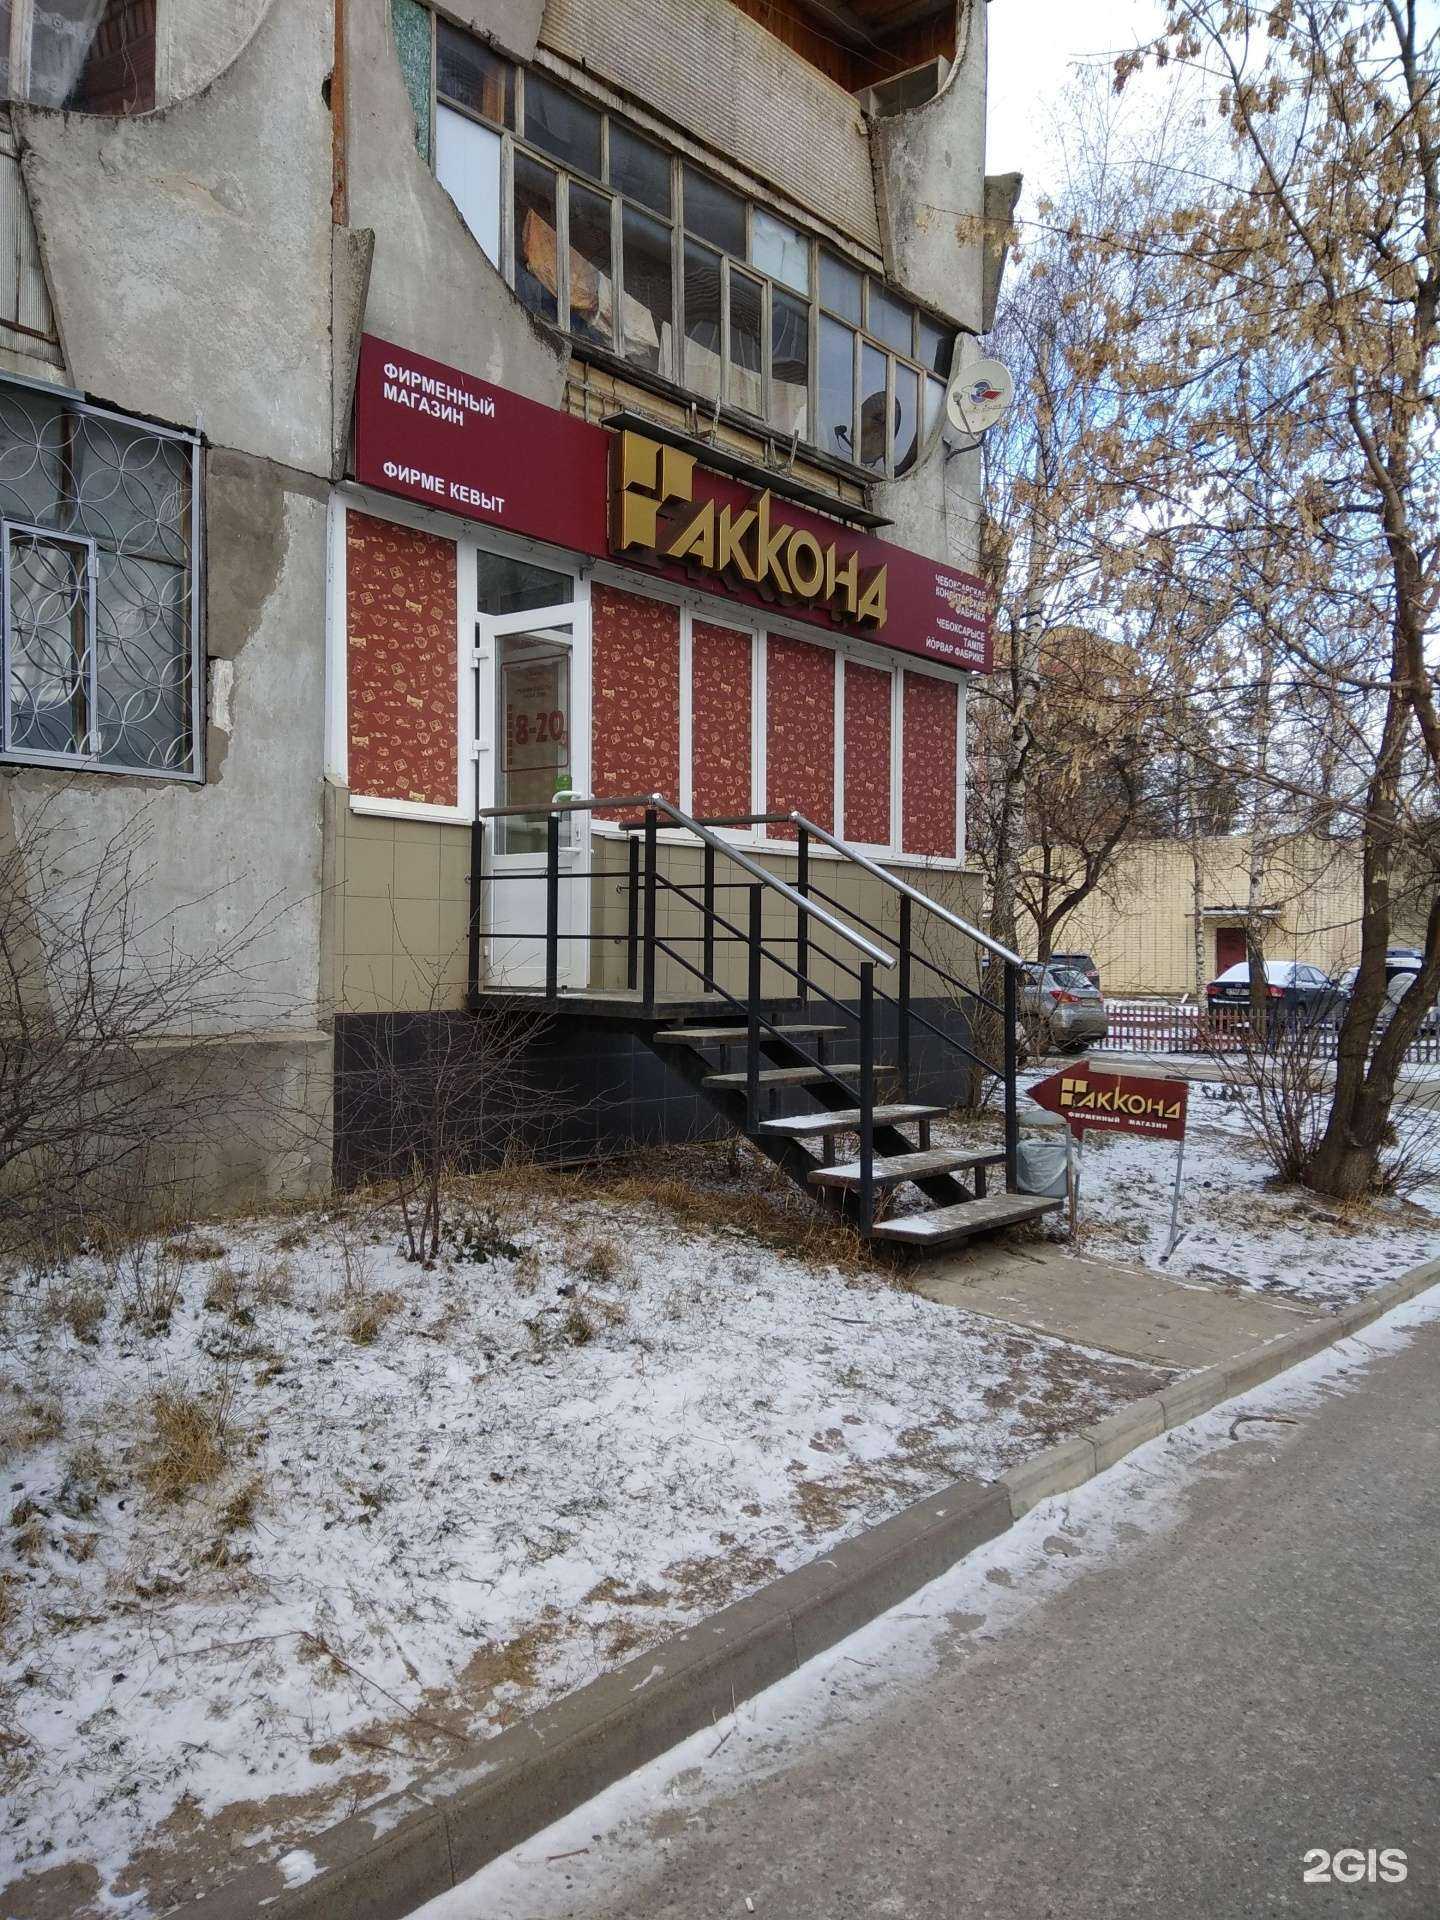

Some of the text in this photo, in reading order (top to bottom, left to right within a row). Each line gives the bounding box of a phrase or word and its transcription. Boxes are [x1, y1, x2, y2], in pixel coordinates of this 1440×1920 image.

[383, 362, 496, 419] ФИРМЕННЫЙ
[383, 382, 464, 426] МАГАЗИН
[383, 460, 505, 514] ФИРМЕ КЕВЫТ
[936, 617, 986, 642] ЧЕБОКСАРЫСЕ
[954, 646, 985, 664] ФАБРИКЕ
[1068, 1111, 1168, 1129] ФИРМЕННЫЙ МАГАЗИН
